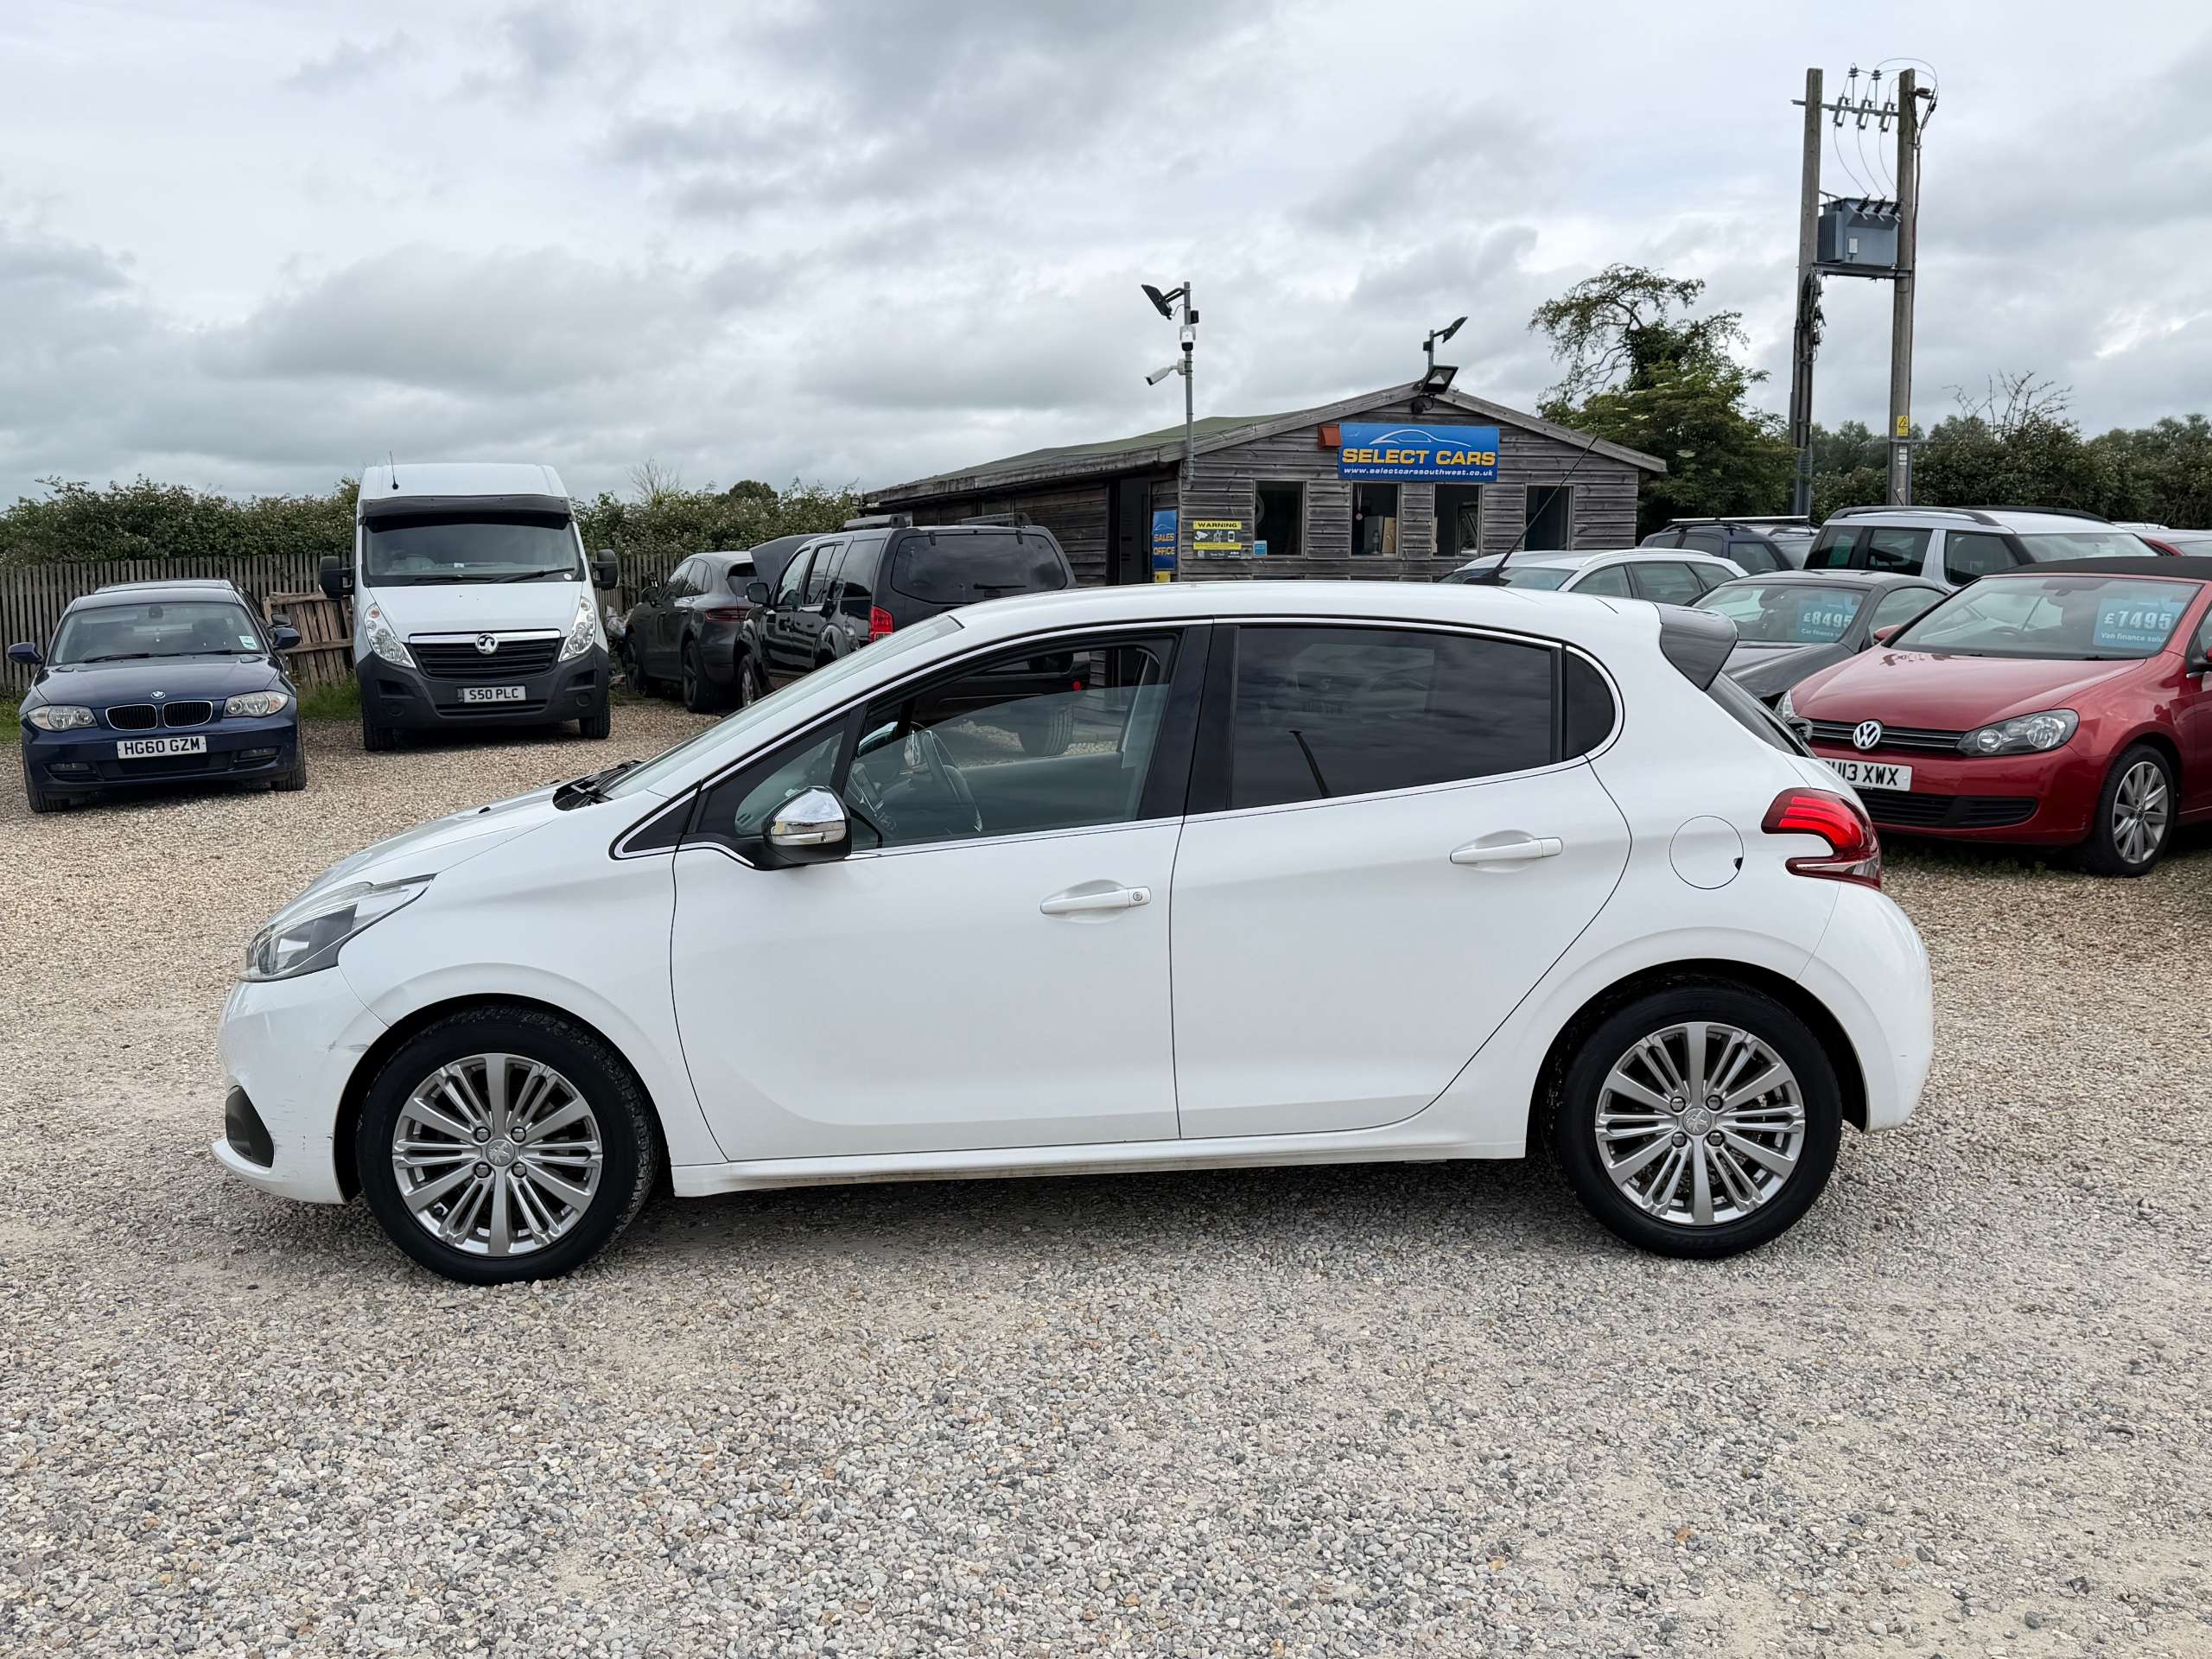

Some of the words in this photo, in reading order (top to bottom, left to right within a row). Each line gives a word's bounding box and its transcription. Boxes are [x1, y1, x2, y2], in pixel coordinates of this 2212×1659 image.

[1342, 448, 1429, 464] SELECT
[1435, 450, 1497, 466] CARS
[1344, 467, 1493, 476] www.selectcarssouthwest.co.uk
[1154, 533, 1174, 542] SALES
[1802, 610, 1853, 629] £8495
[2104, 611, 2171, 630] £7495
[469, 689, 493, 700] S50
[496, 688, 519, 699] PLC
[124, 740, 165, 755] HG60
[169, 737, 200, 753] GZM
[1862, 764, 1899, 786] XWX
